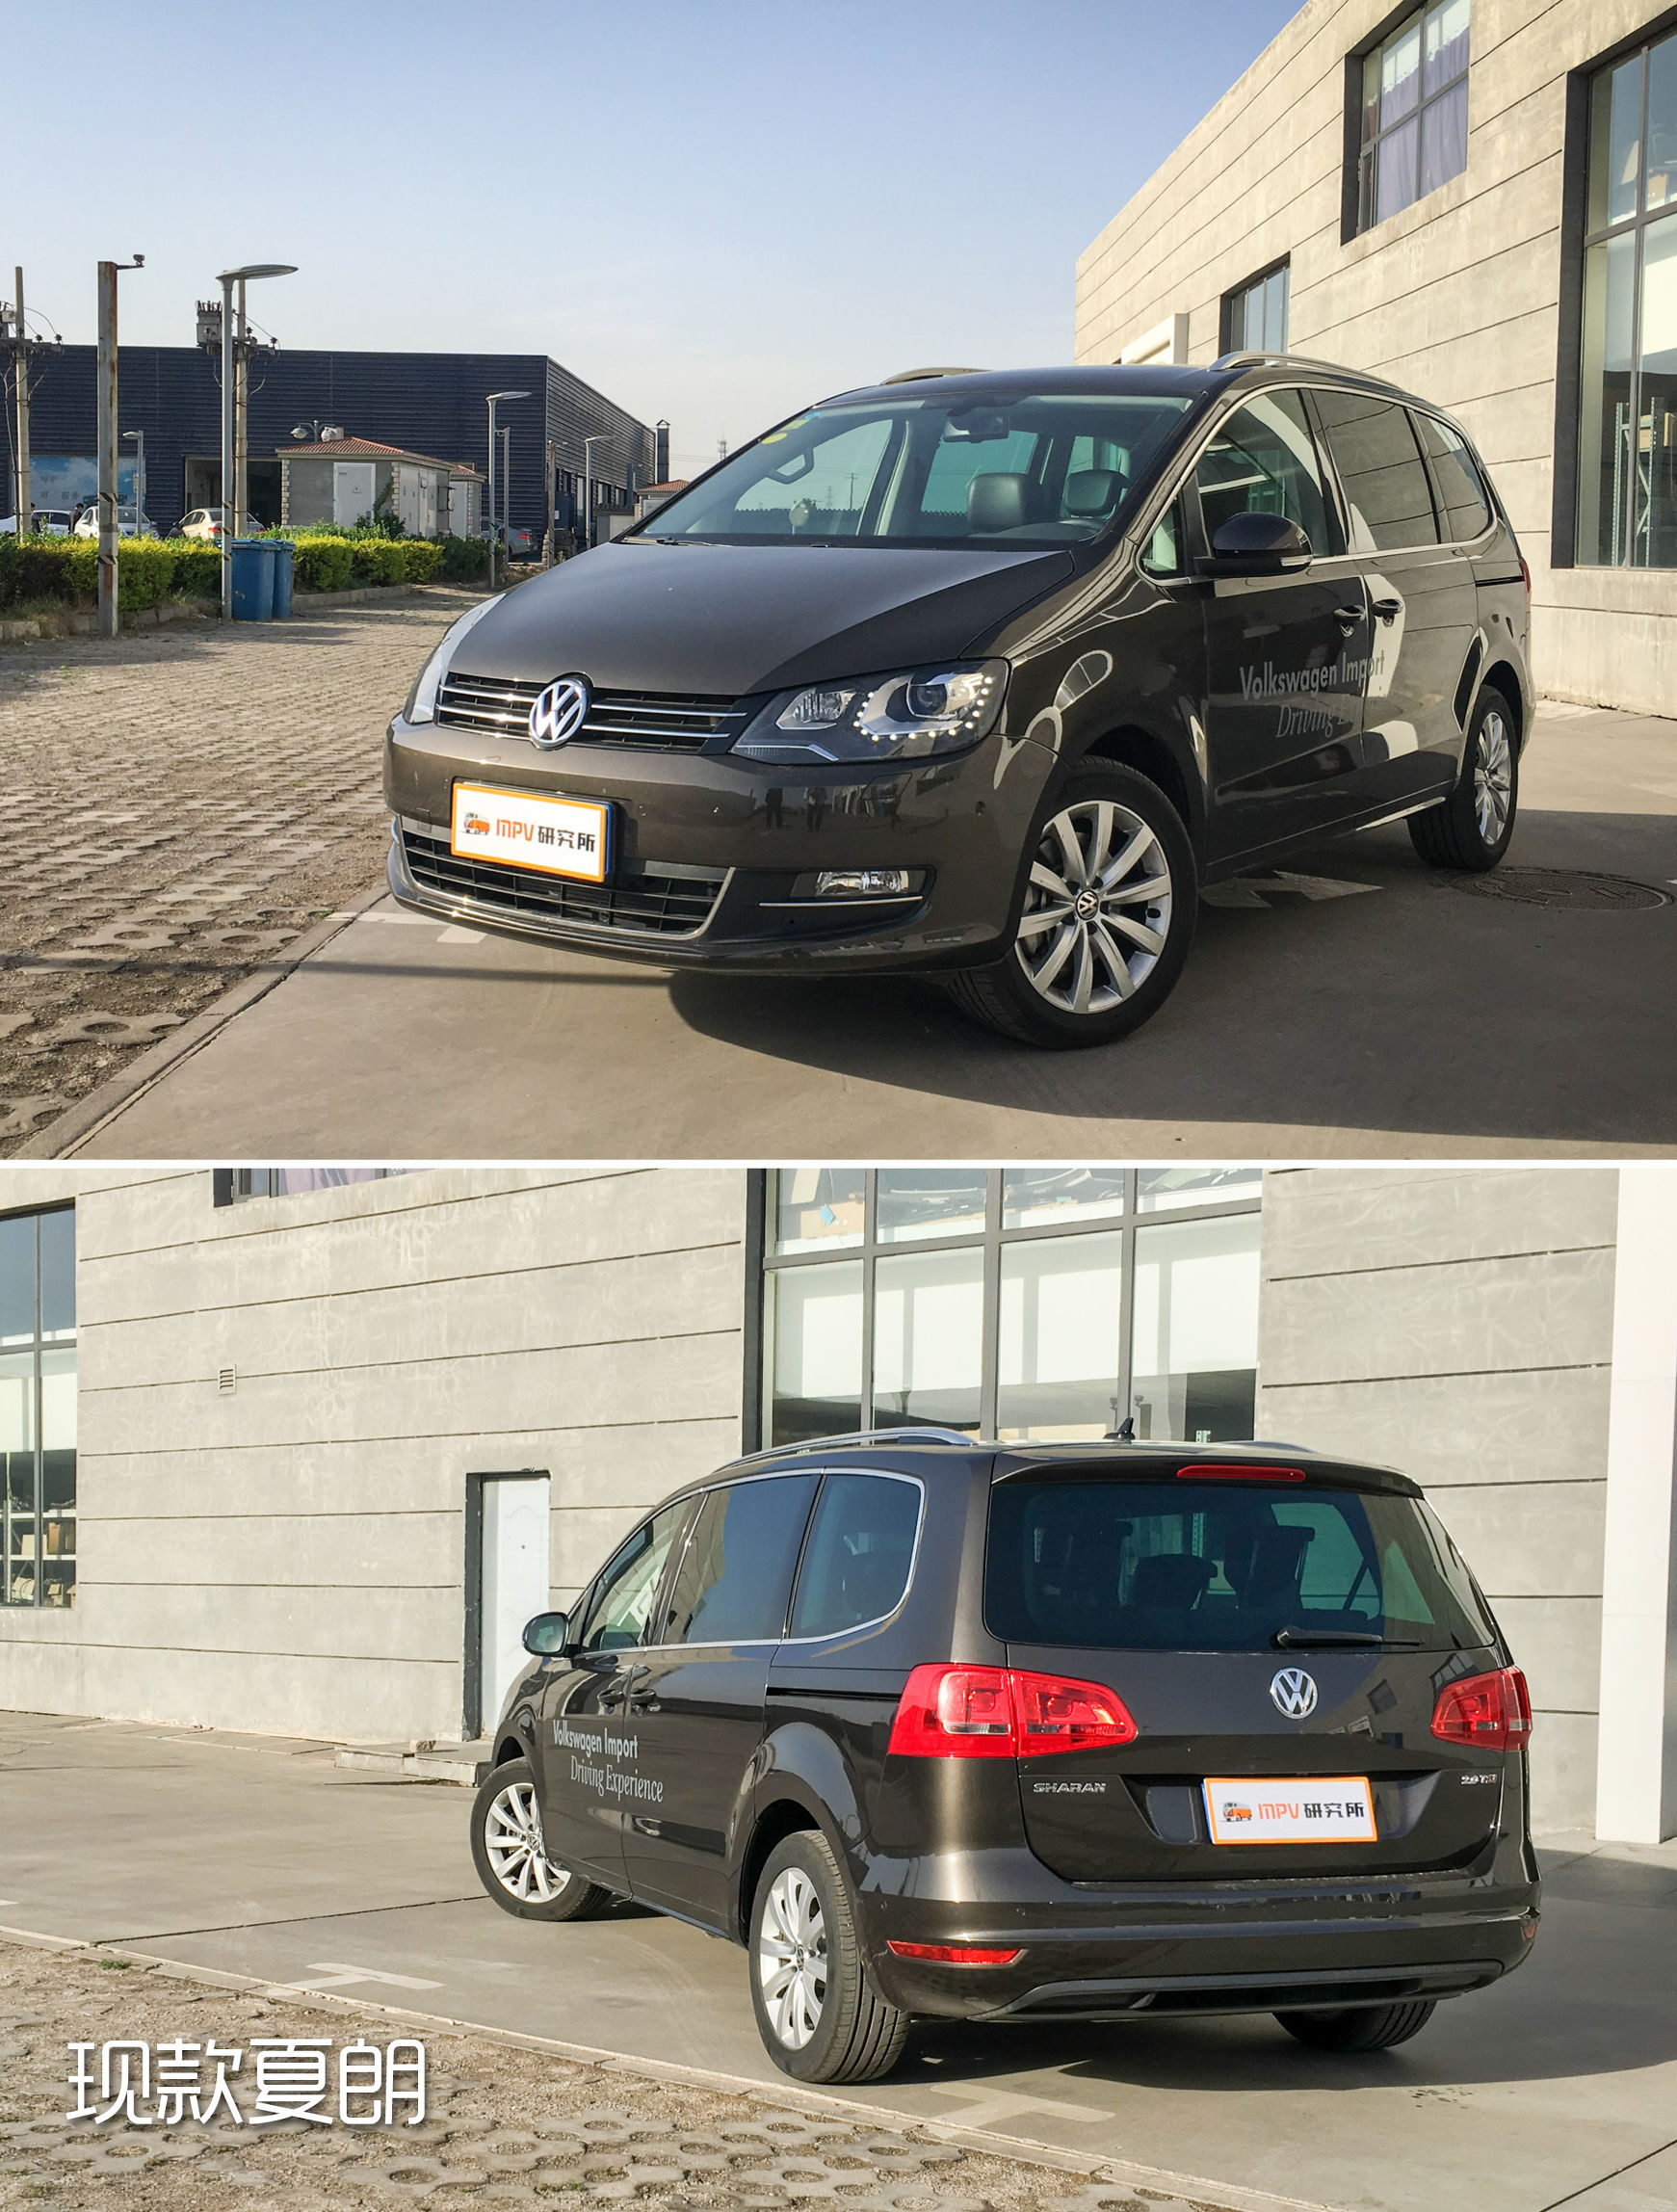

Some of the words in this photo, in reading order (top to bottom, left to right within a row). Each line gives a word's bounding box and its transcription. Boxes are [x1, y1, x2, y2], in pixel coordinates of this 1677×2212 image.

[1240, 661, 1337, 699] Volkswagen
[1342, 650, 1385, 687] Import
[496, 818, 534, 841] MPV
[537, 826, 595, 852] 研究所
[553, 1720, 602, 1758] Volkswagen
[604, 1727, 638, 1763] Import
[571, 1755, 604, 1797] Driving
[606, 1764, 664, 1803] Experience
[1033, 1782, 1107, 1793] SHARAN
[1258, 1804, 1298, 1820] MPV
[1303, 1802, 1364, 1819] 研究所
